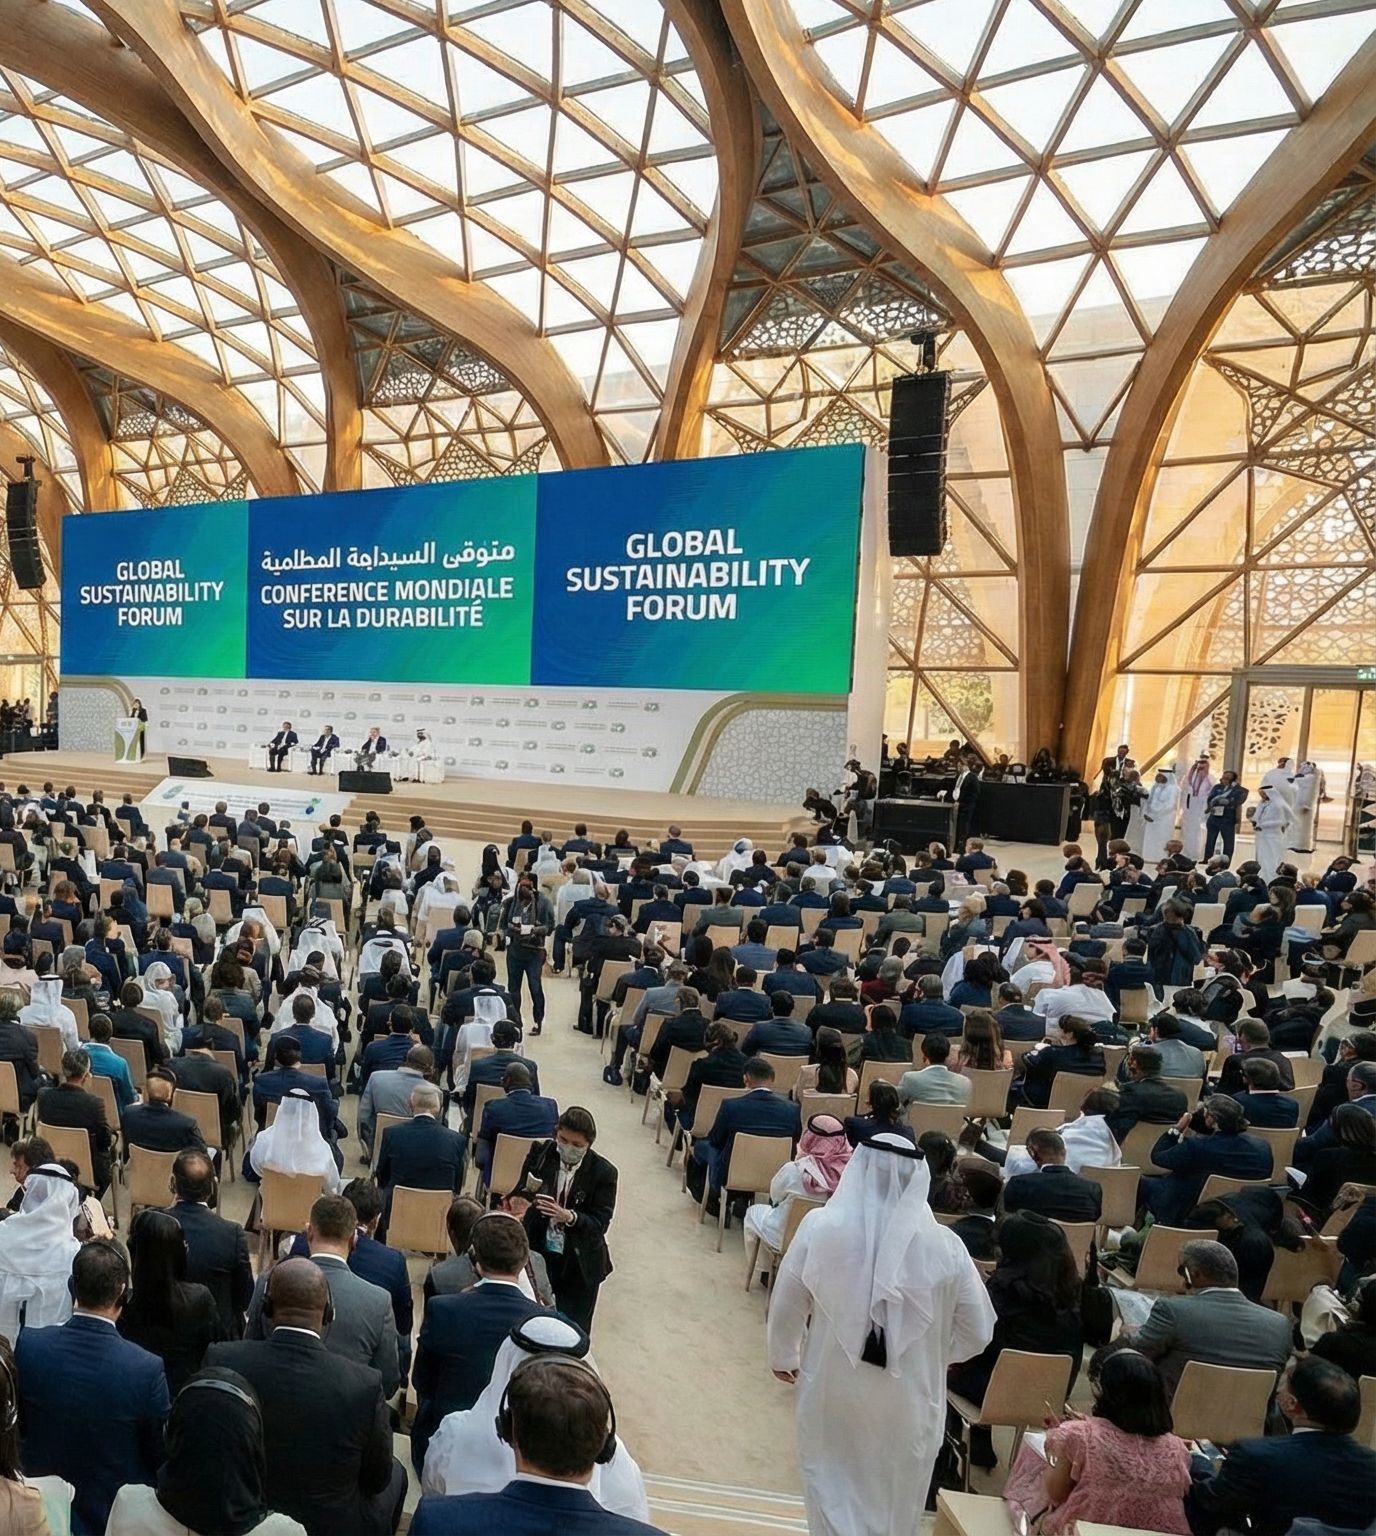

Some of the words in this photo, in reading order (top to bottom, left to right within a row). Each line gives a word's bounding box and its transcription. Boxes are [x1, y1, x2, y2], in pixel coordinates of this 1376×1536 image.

[626, 528, 743, 559] GLOBAL
[116, 559, 185, 581] GLOBAL
[566, 557, 811, 592] SUSTAINABILITY
[80, 581, 224, 604] SUSTAINABILITY
[261, 581, 389, 604] CONFERENCE
[395, 577, 514, 601] MONDIALE
[118, 606, 183, 626] FORUM
[283, 608, 322, 629] SUR
[327, 608, 351, 628] LA
[355, 599, 484, 628] DURABILITÉ
[626, 593, 737, 621] FORUM
